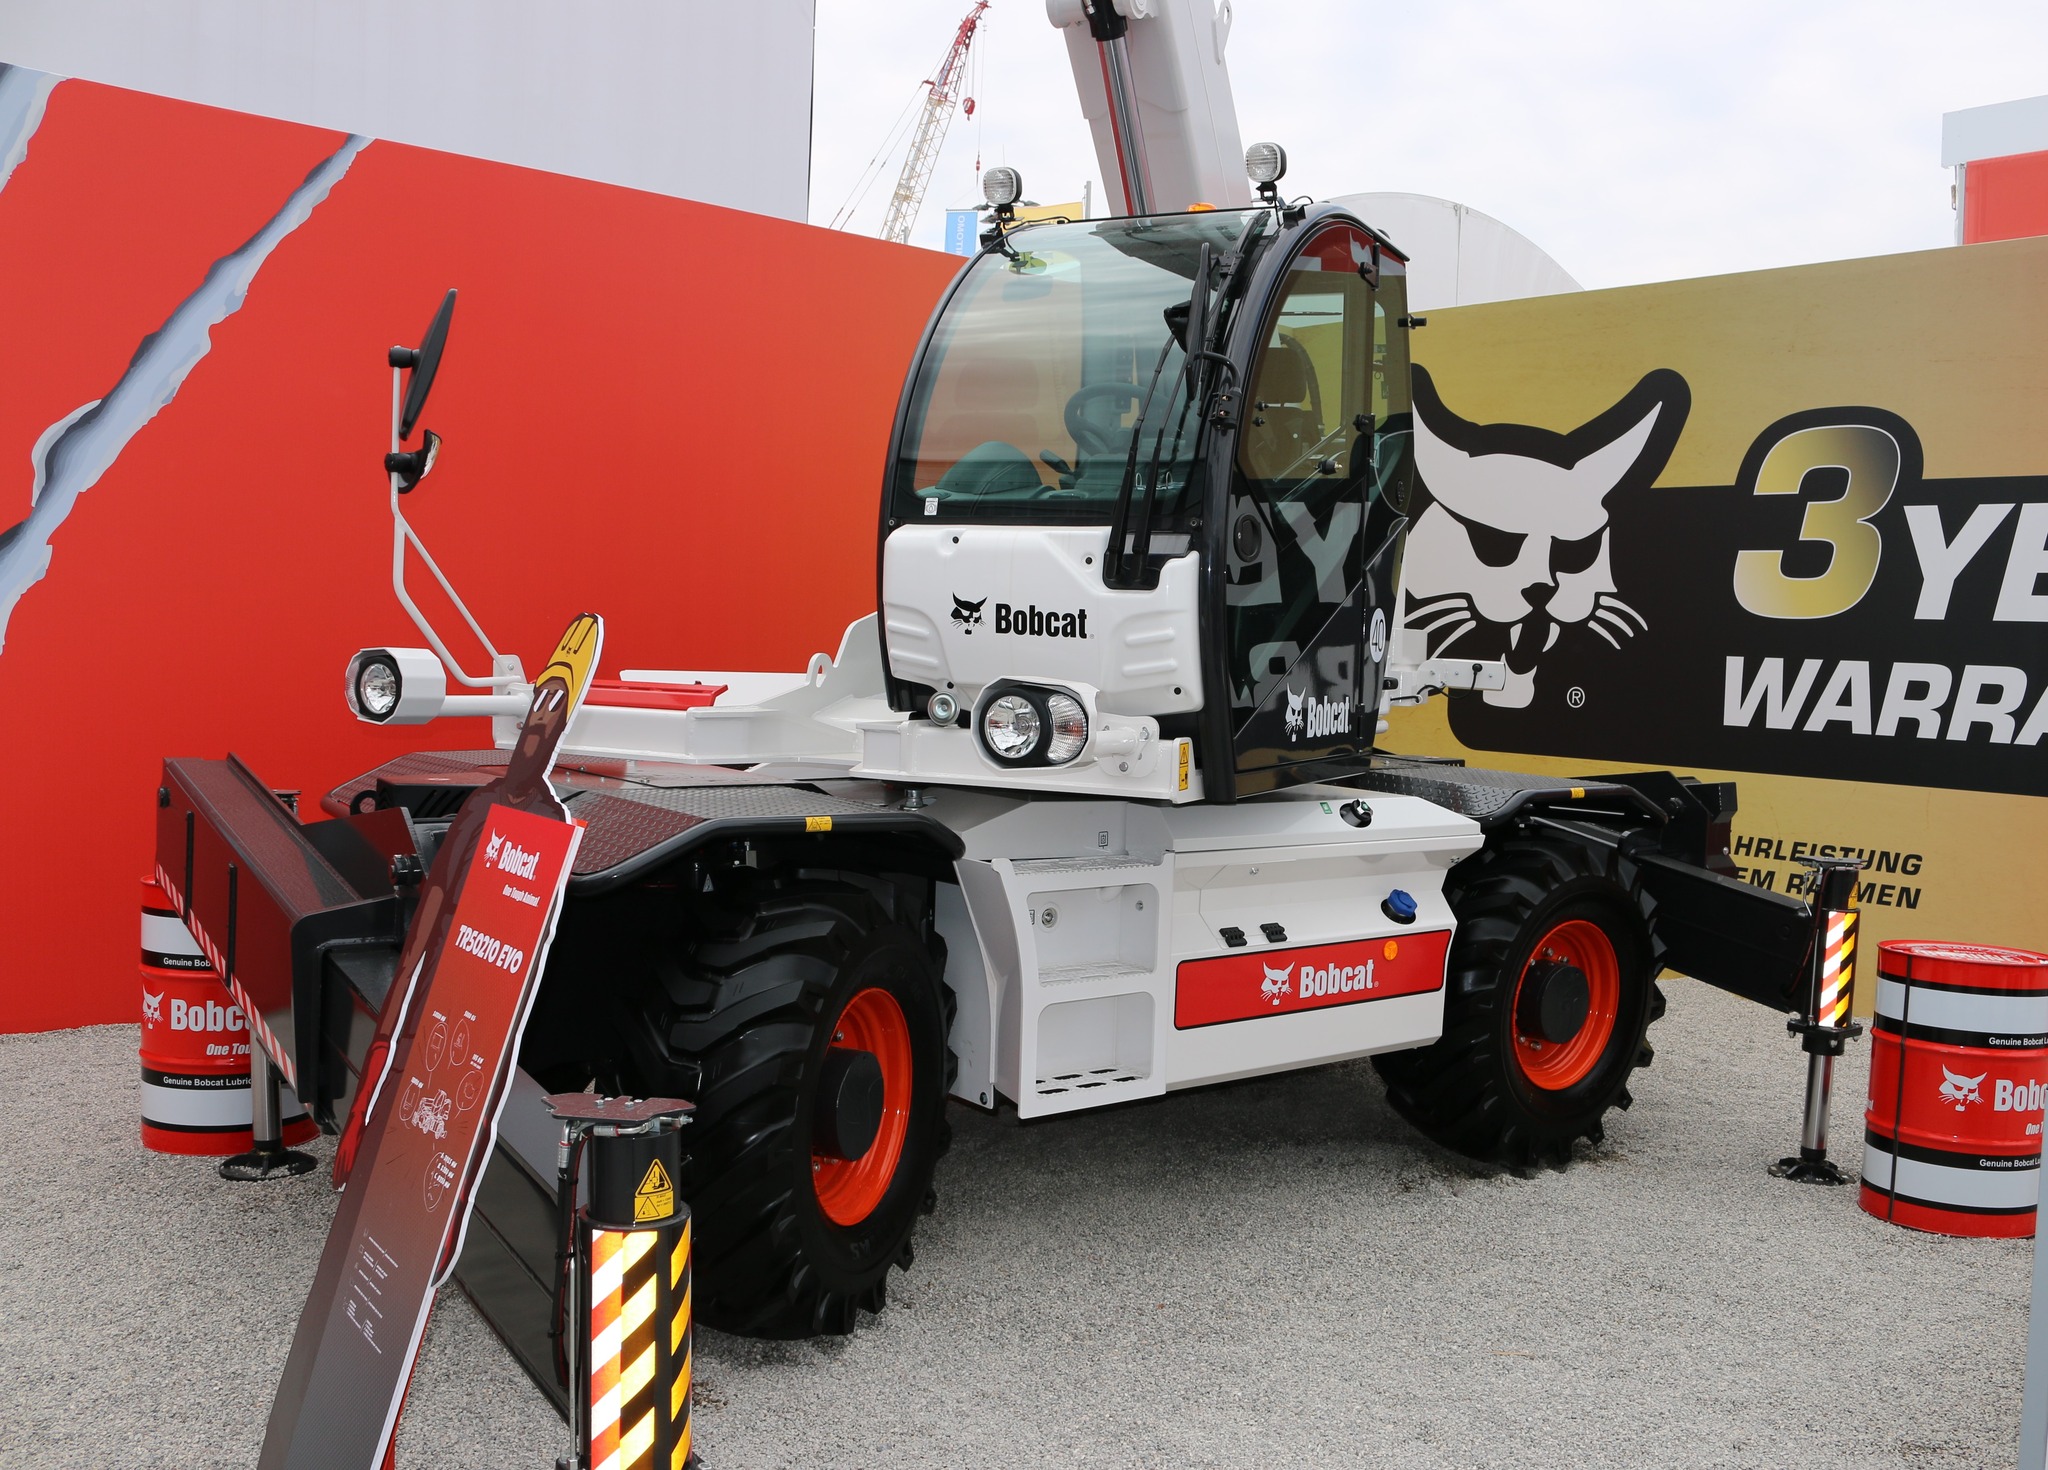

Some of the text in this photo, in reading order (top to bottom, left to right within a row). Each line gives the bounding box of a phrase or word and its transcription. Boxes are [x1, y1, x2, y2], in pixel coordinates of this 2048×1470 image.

[1733, 424, 1900, 620] 3
[995, 603, 1087, 639] Bobcat
[1371, 618, 1385, 654] 40
[1306, 695, 1350, 738] Bobcat
[498, 841, 541, 881] Bobcat
[1730, 835, 1923, 876] HRLEISTUNG
[163, 957, 193, 967] Genuine
[455, 924, 524, 974] TR50210 EVO
[1299, 959, 1374, 999] Bobcat
[206, 1043, 229, 1056] One
[1988, 1036, 2022, 1046] Genuine
[2023, 1037, 2043, 1046] Bobcat
[163, 1076, 193, 1086] Genuine
[194, 1079, 224, 1087] Bobcat
[2025, 1122, 2040, 1136] One
[1979, 1158, 2013, 1168] Genuine
[2013, 1158, 2035, 1168] Bobcat
